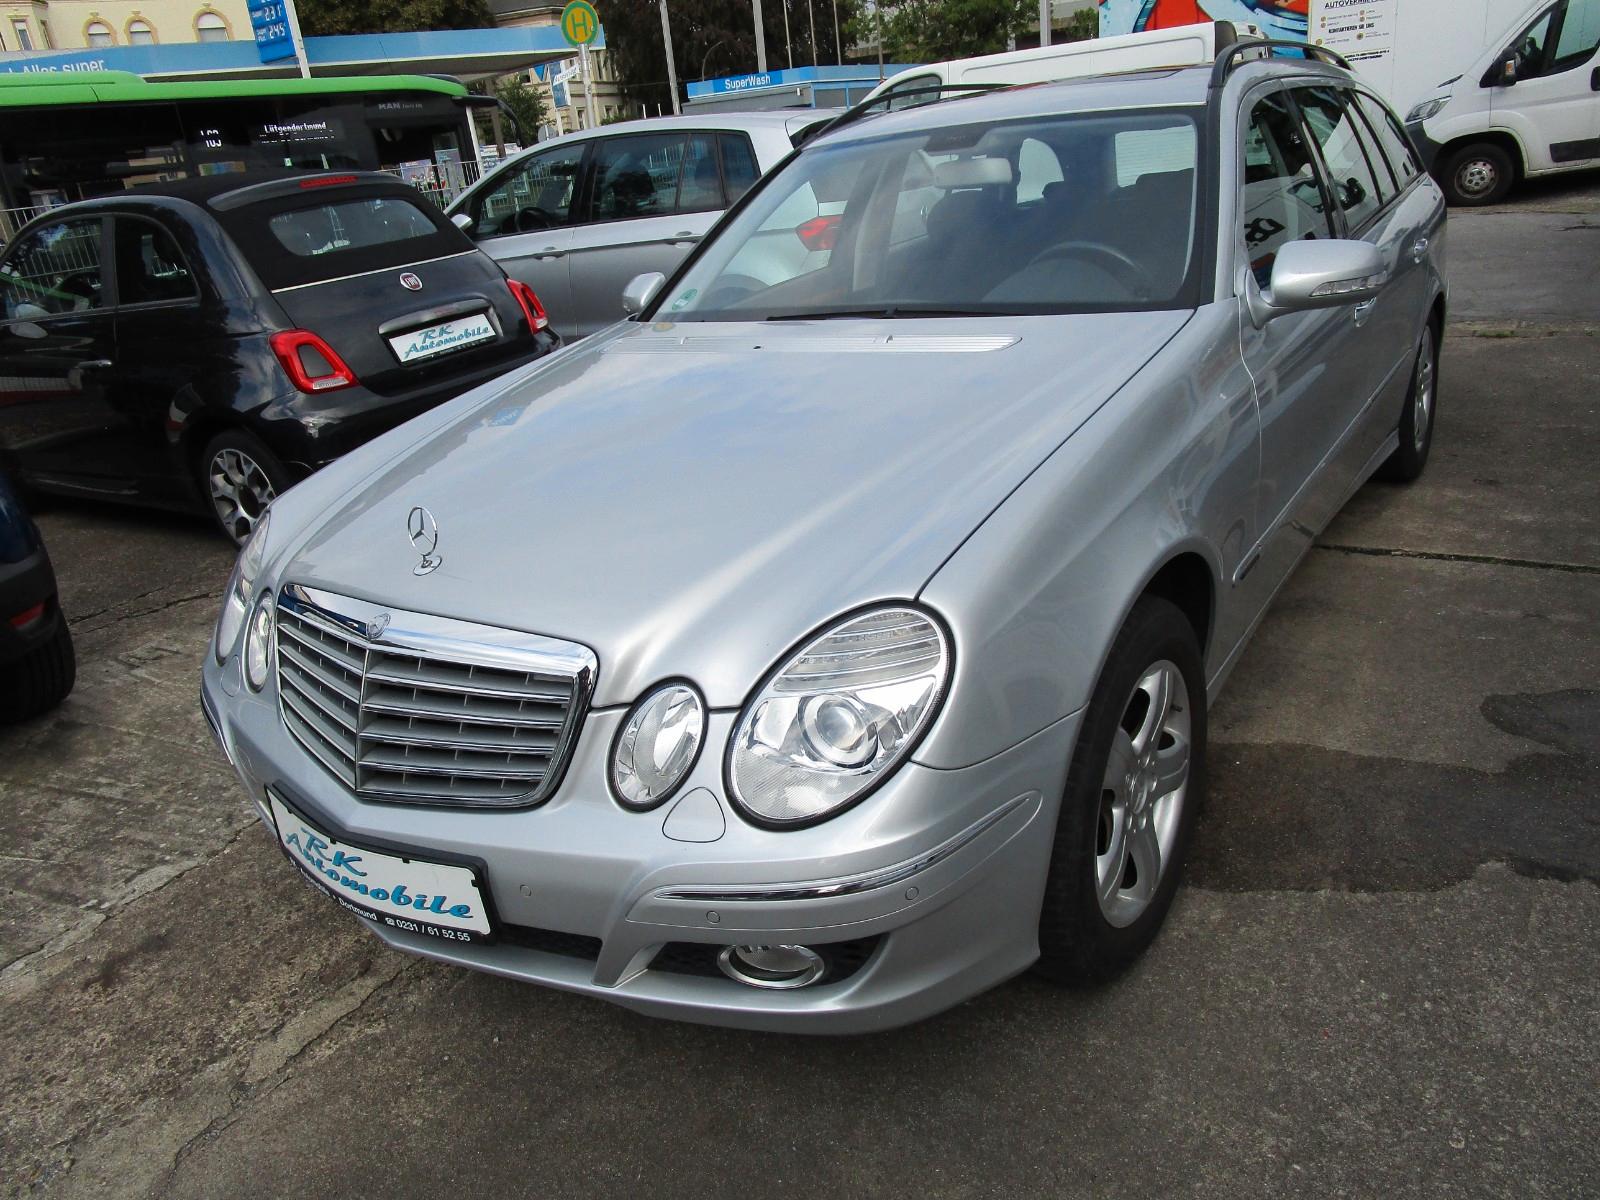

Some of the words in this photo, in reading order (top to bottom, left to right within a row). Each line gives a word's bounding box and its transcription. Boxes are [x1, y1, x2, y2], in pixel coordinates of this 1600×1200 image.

[571, 11, 588, 38] H
[724, 75, 771, 90] SuperWash
[404, 325, 490, 359] Automobile
[418, 323, 455, 344] RK
[300, 828, 367, 877] RK
[285, 832, 474, 919] Automobile
[338, 898, 378, 921] Dortmund
[396, 919, 419, 932] 0231
[428, 926, 440, 937] 61
[442, 929, 455, 940] 52
[457, 931, 471, 942] 55
